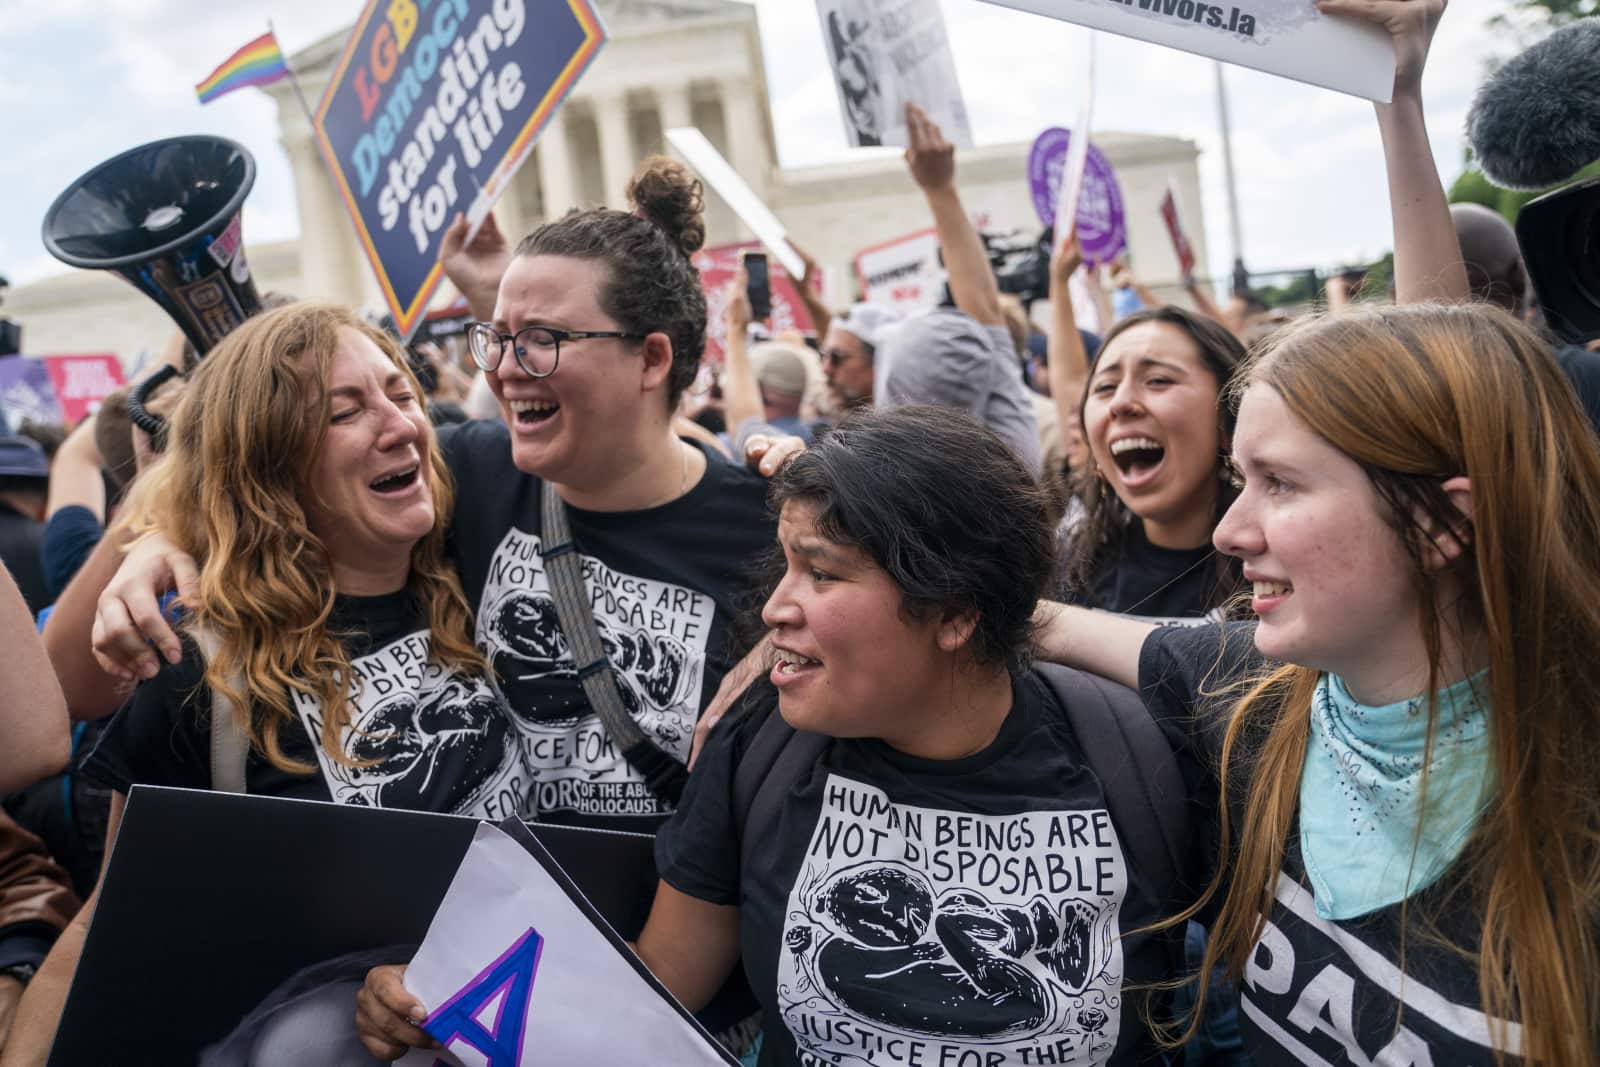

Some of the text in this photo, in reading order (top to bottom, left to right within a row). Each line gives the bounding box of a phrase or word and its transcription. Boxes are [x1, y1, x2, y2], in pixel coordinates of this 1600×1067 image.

[353, 0, 431, 124] LGB
[378, 0, 526, 231] standing
[408, 153, 458, 253] for
[452, 61, 526, 168] life
[489, 555, 700, 643] NOT POSABLE
[656, 588, 703, 617] ARE
[580, 783, 597, 797] OF
[599, 783, 623, 798] THE
[580, 798, 658, 813] HOLOCAUST
[828, 785, 1113, 852] HUMAN BEINGS ARE
[811, 816, 1115, 897] NOT DISPOSABLE
[793, 1013, 926, 1067] JUSTICE
[940, 1044, 1007, 1067] FOR
[1016, 1038, 1076, 1066] THE
